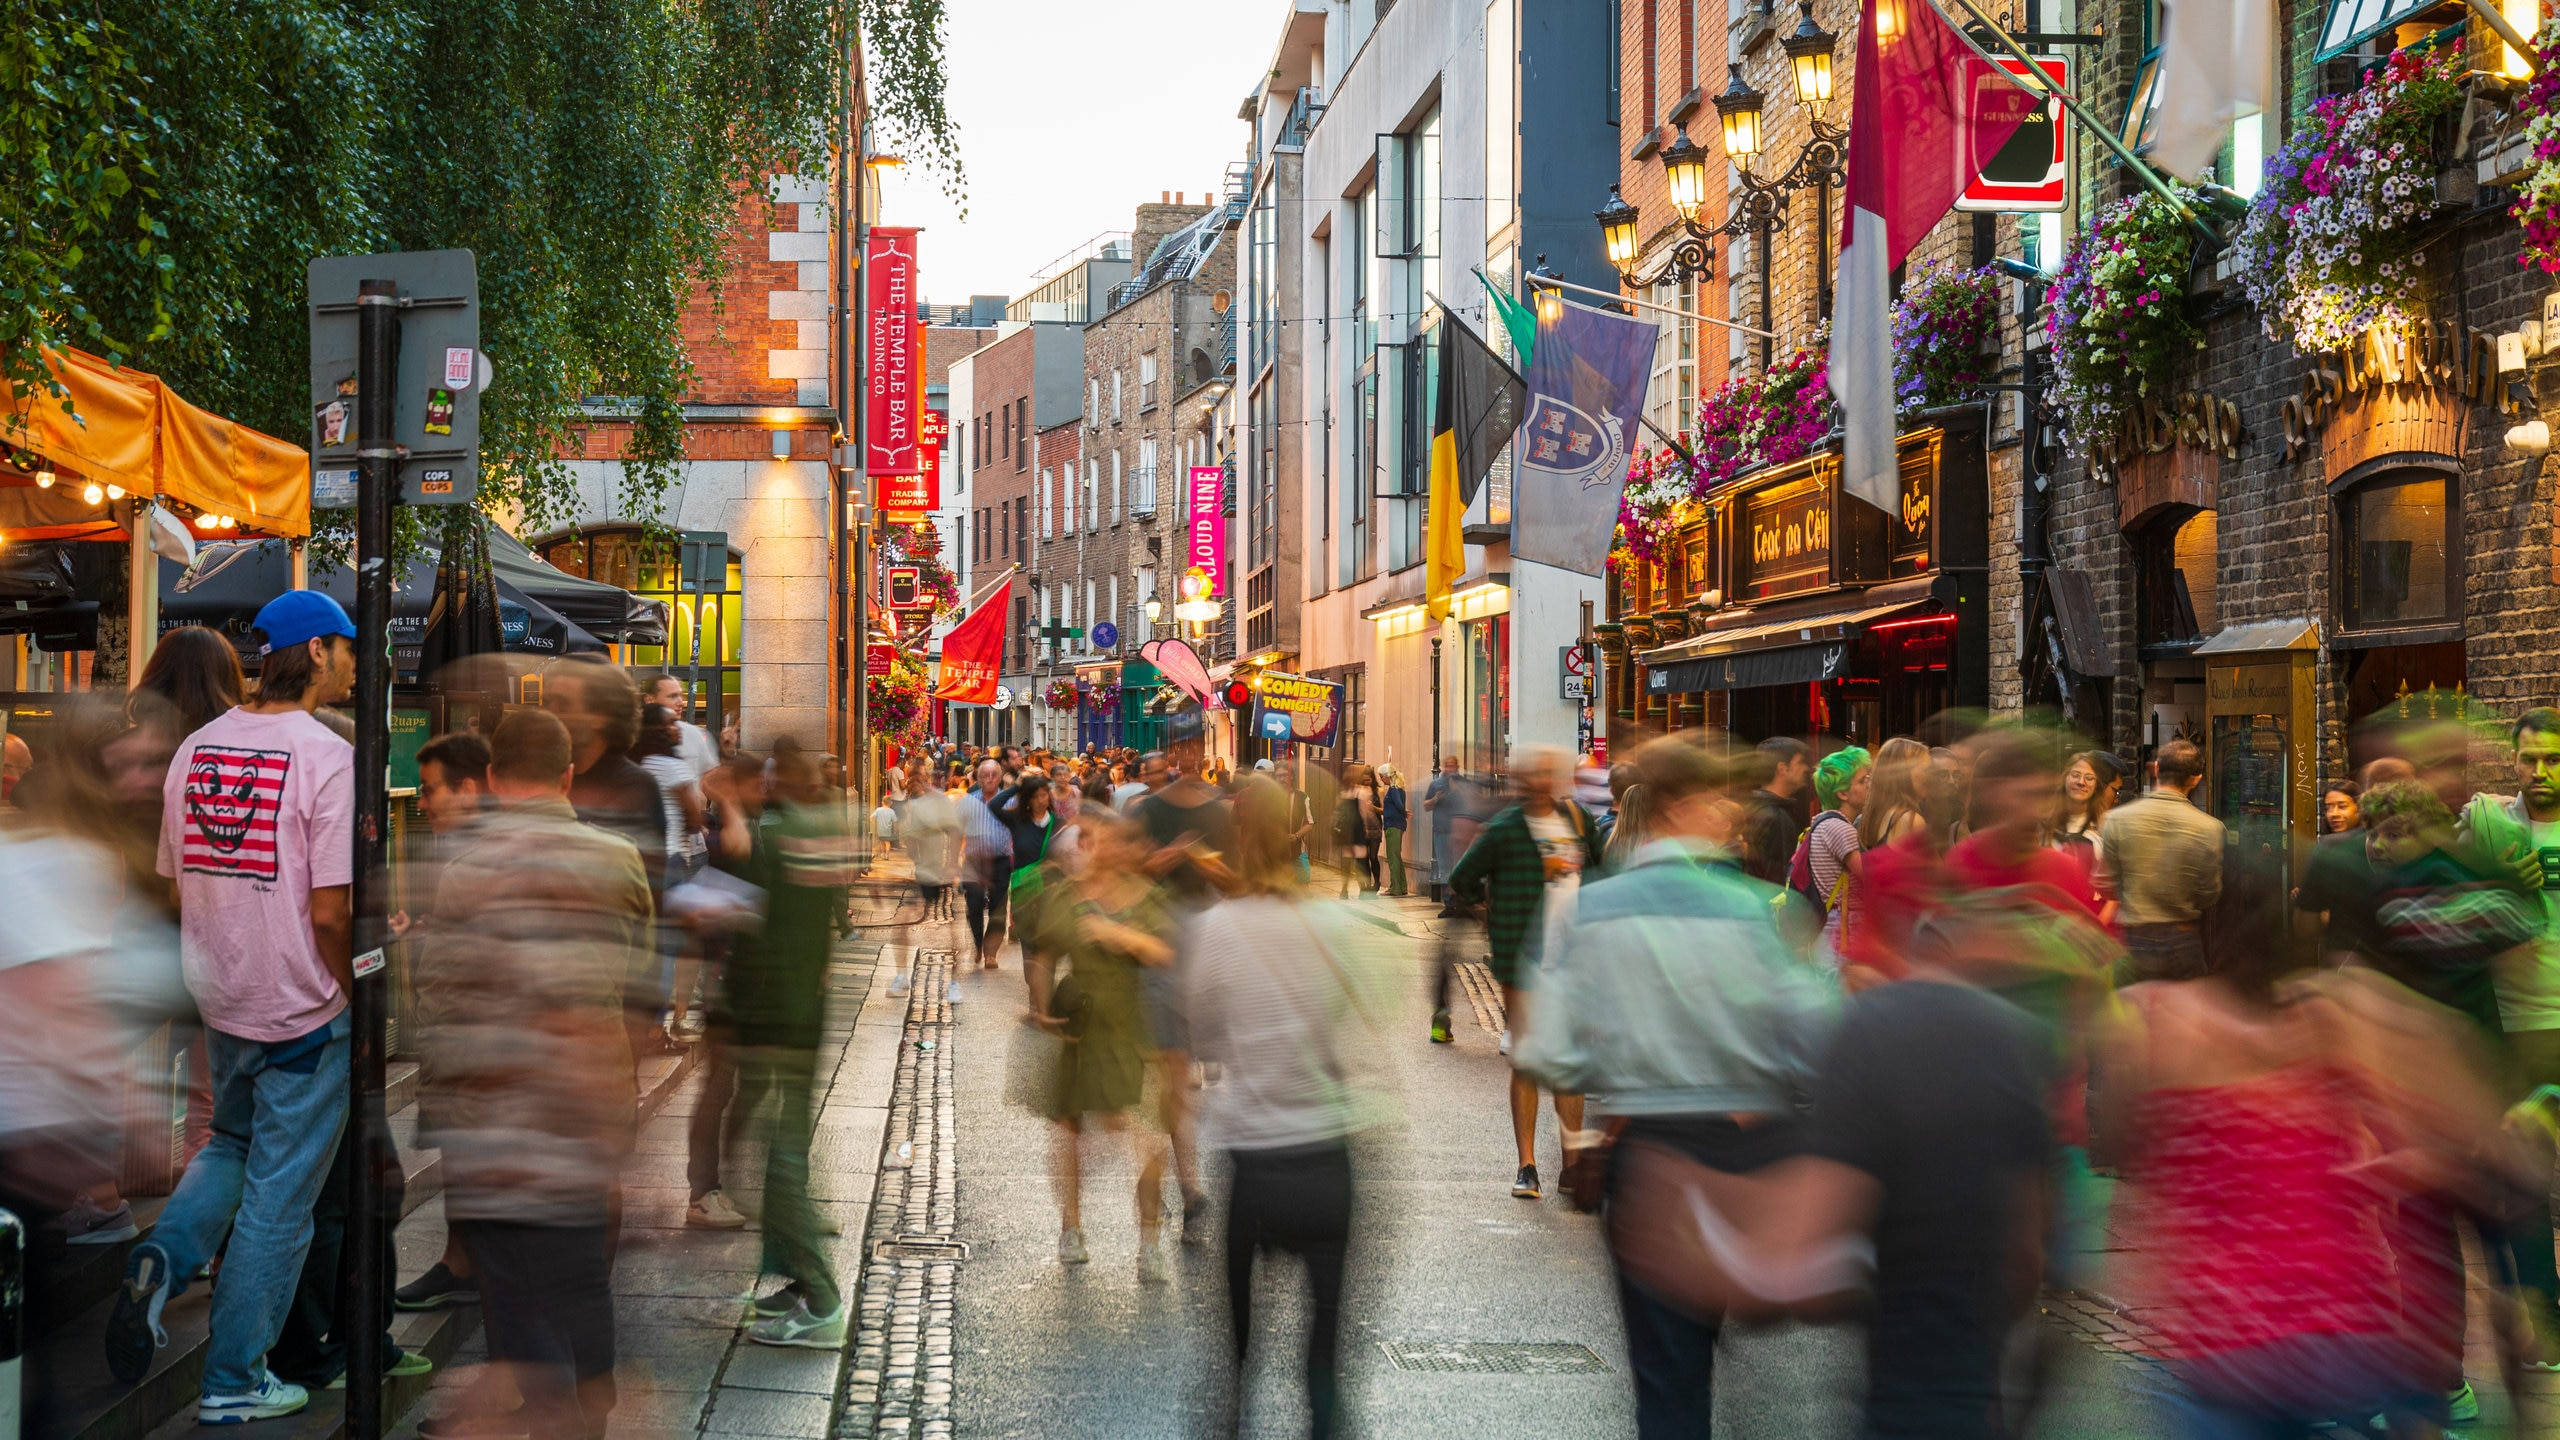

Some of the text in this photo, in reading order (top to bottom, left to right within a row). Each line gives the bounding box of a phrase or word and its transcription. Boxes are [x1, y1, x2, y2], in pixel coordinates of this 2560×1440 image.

[1984, 111, 2044, 123] GUINNESS
[874, 306, 886, 398] TRADING CO.
[890, 262, 906, 441] THE TEMPLE BAR
[424, 471, 450, 480] COPS
[425, 483, 449, 491] COPS
[1196, 471, 1219, 514] NINE
[891, 490, 928, 498] TRADING
[888, 498, 930, 506] COMPANY
[1785, 522, 1801, 558] na
[405, 617, 420, 626] THE
[961, 660, 982, 669] THE
[945, 666, 995, 681] TEMPLE
[956, 678, 981, 689] BAR
[1262, 677, 1333, 701] COMEDY
[1566, 682, 1580, 692] 24
[1263, 696, 1323, 714] TONIGHT
